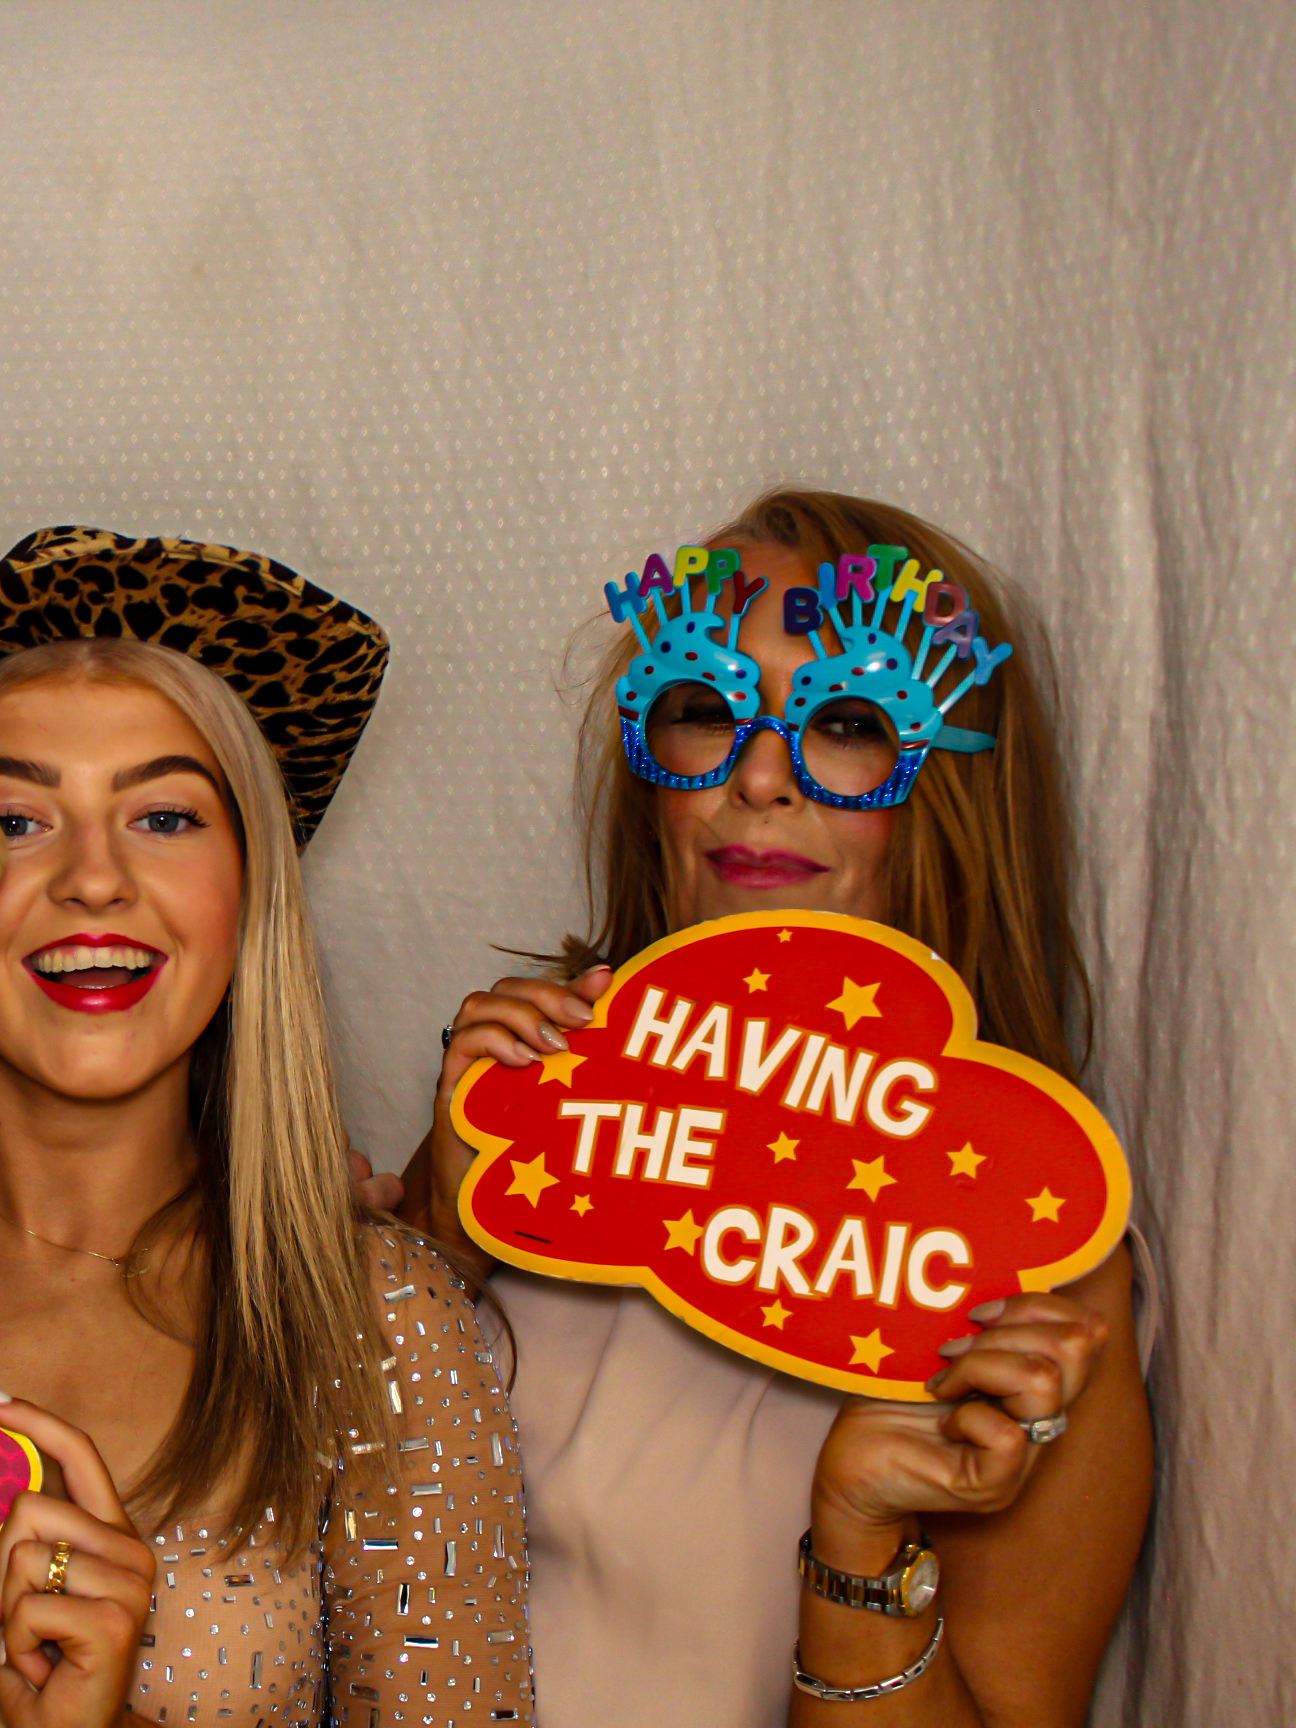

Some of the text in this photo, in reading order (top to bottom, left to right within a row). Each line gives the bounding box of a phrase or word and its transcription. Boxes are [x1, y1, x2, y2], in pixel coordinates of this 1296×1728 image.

[604, 545, 769, 622] HAPPY
[782, 544, 1013, 685] BIRTHDAY
[624, 987, 936, 1137] HAVING
[559, 1102, 724, 1187] THE
[703, 1206, 971, 1309] CRAIC
